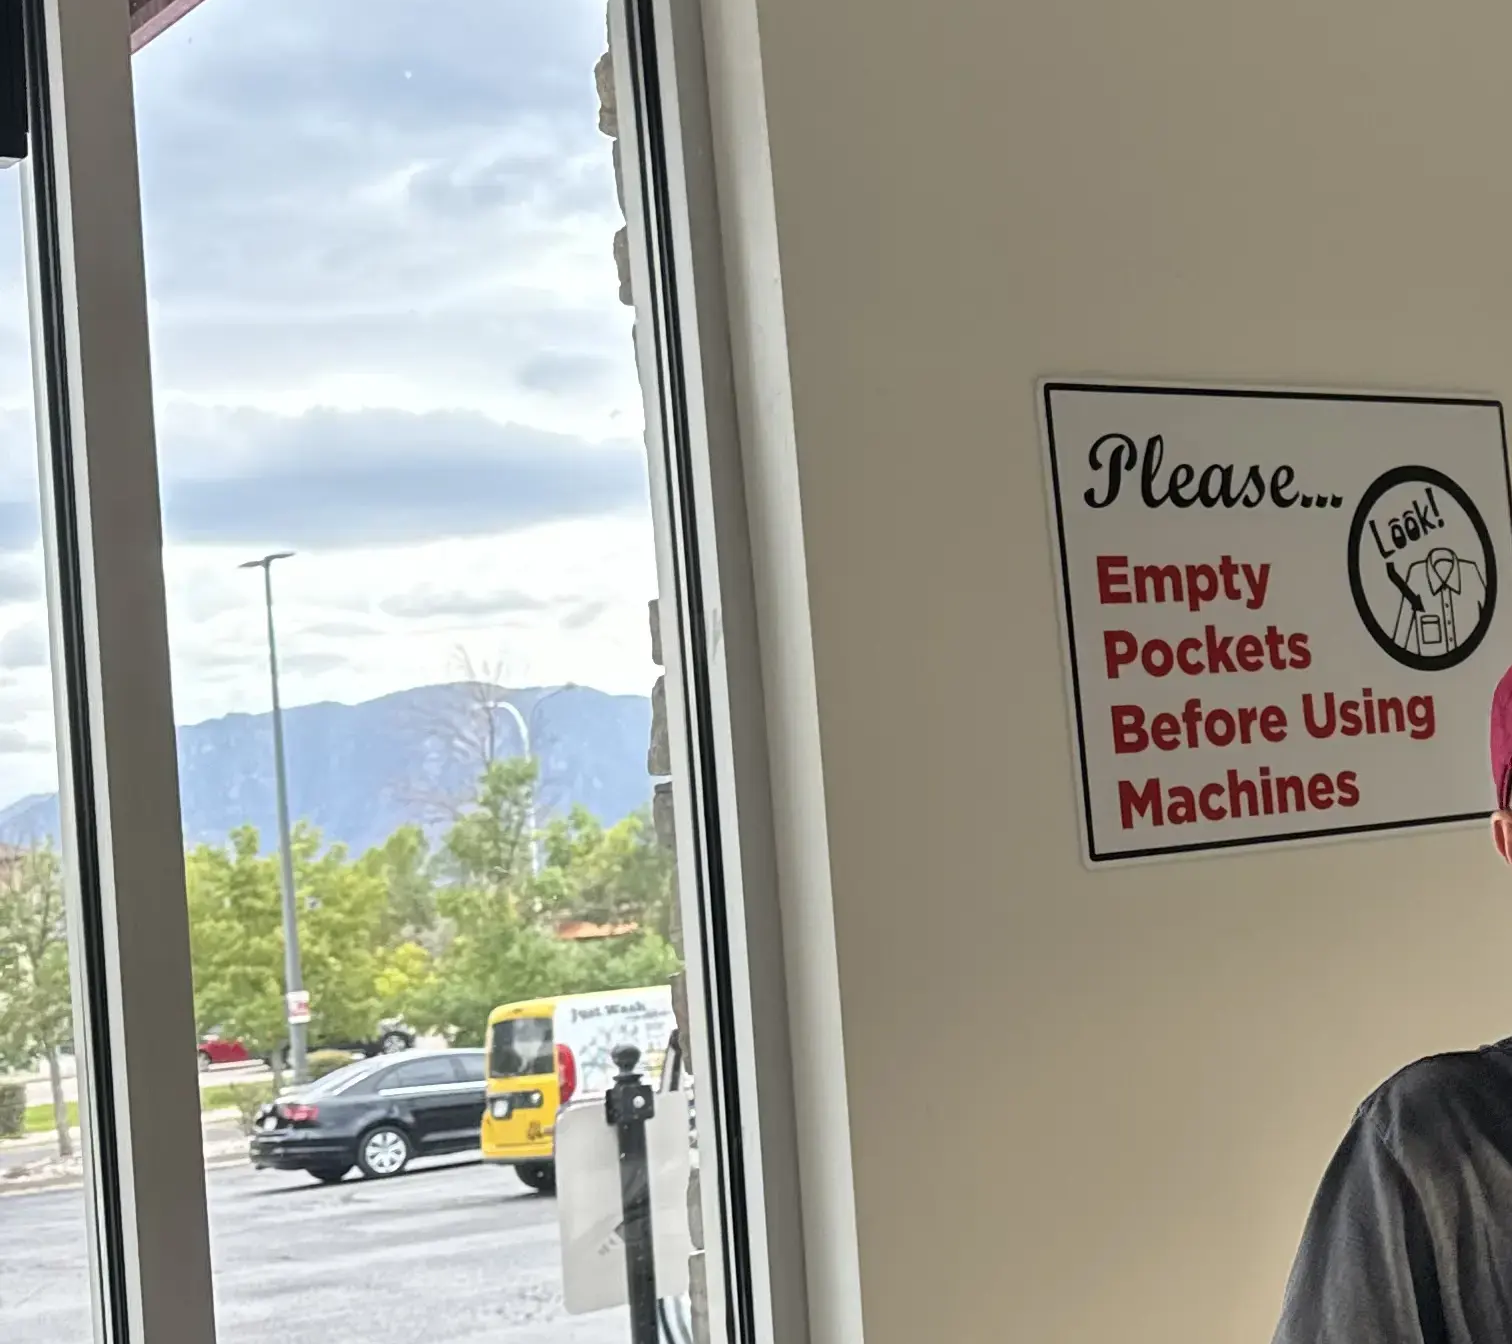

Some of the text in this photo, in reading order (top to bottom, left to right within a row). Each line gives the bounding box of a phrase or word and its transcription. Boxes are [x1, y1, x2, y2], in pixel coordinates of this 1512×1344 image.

[1083, 432, 1344, 510] Please...
[1096, 554, 1272, 613] Empty
[1102, 623, 1313, 680] Pockets
[1110, 686, 1438, 755] Before Using
[1117, 765, 1361, 830] Machines
